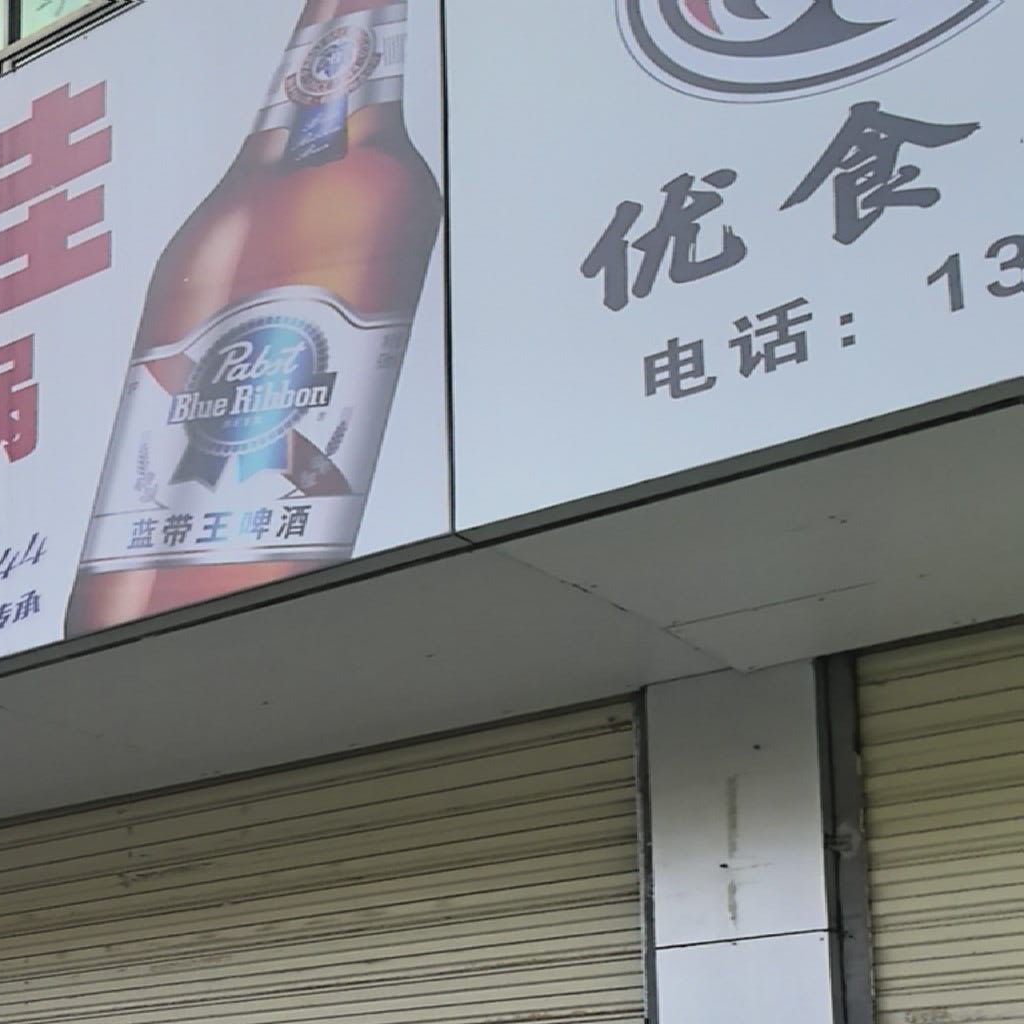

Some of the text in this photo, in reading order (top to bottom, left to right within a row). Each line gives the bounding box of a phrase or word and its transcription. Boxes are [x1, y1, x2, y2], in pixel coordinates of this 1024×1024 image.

[580, 101, 1024, 311] 优食
[927, 234, 1024, 313] 13
[211, 340, 307, 384] Pabst
[171, 391, 228, 423] Blue
[229, 380, 329, 415] Ribbon
[127, 505, 312, 550] 蓝带王啤酒
